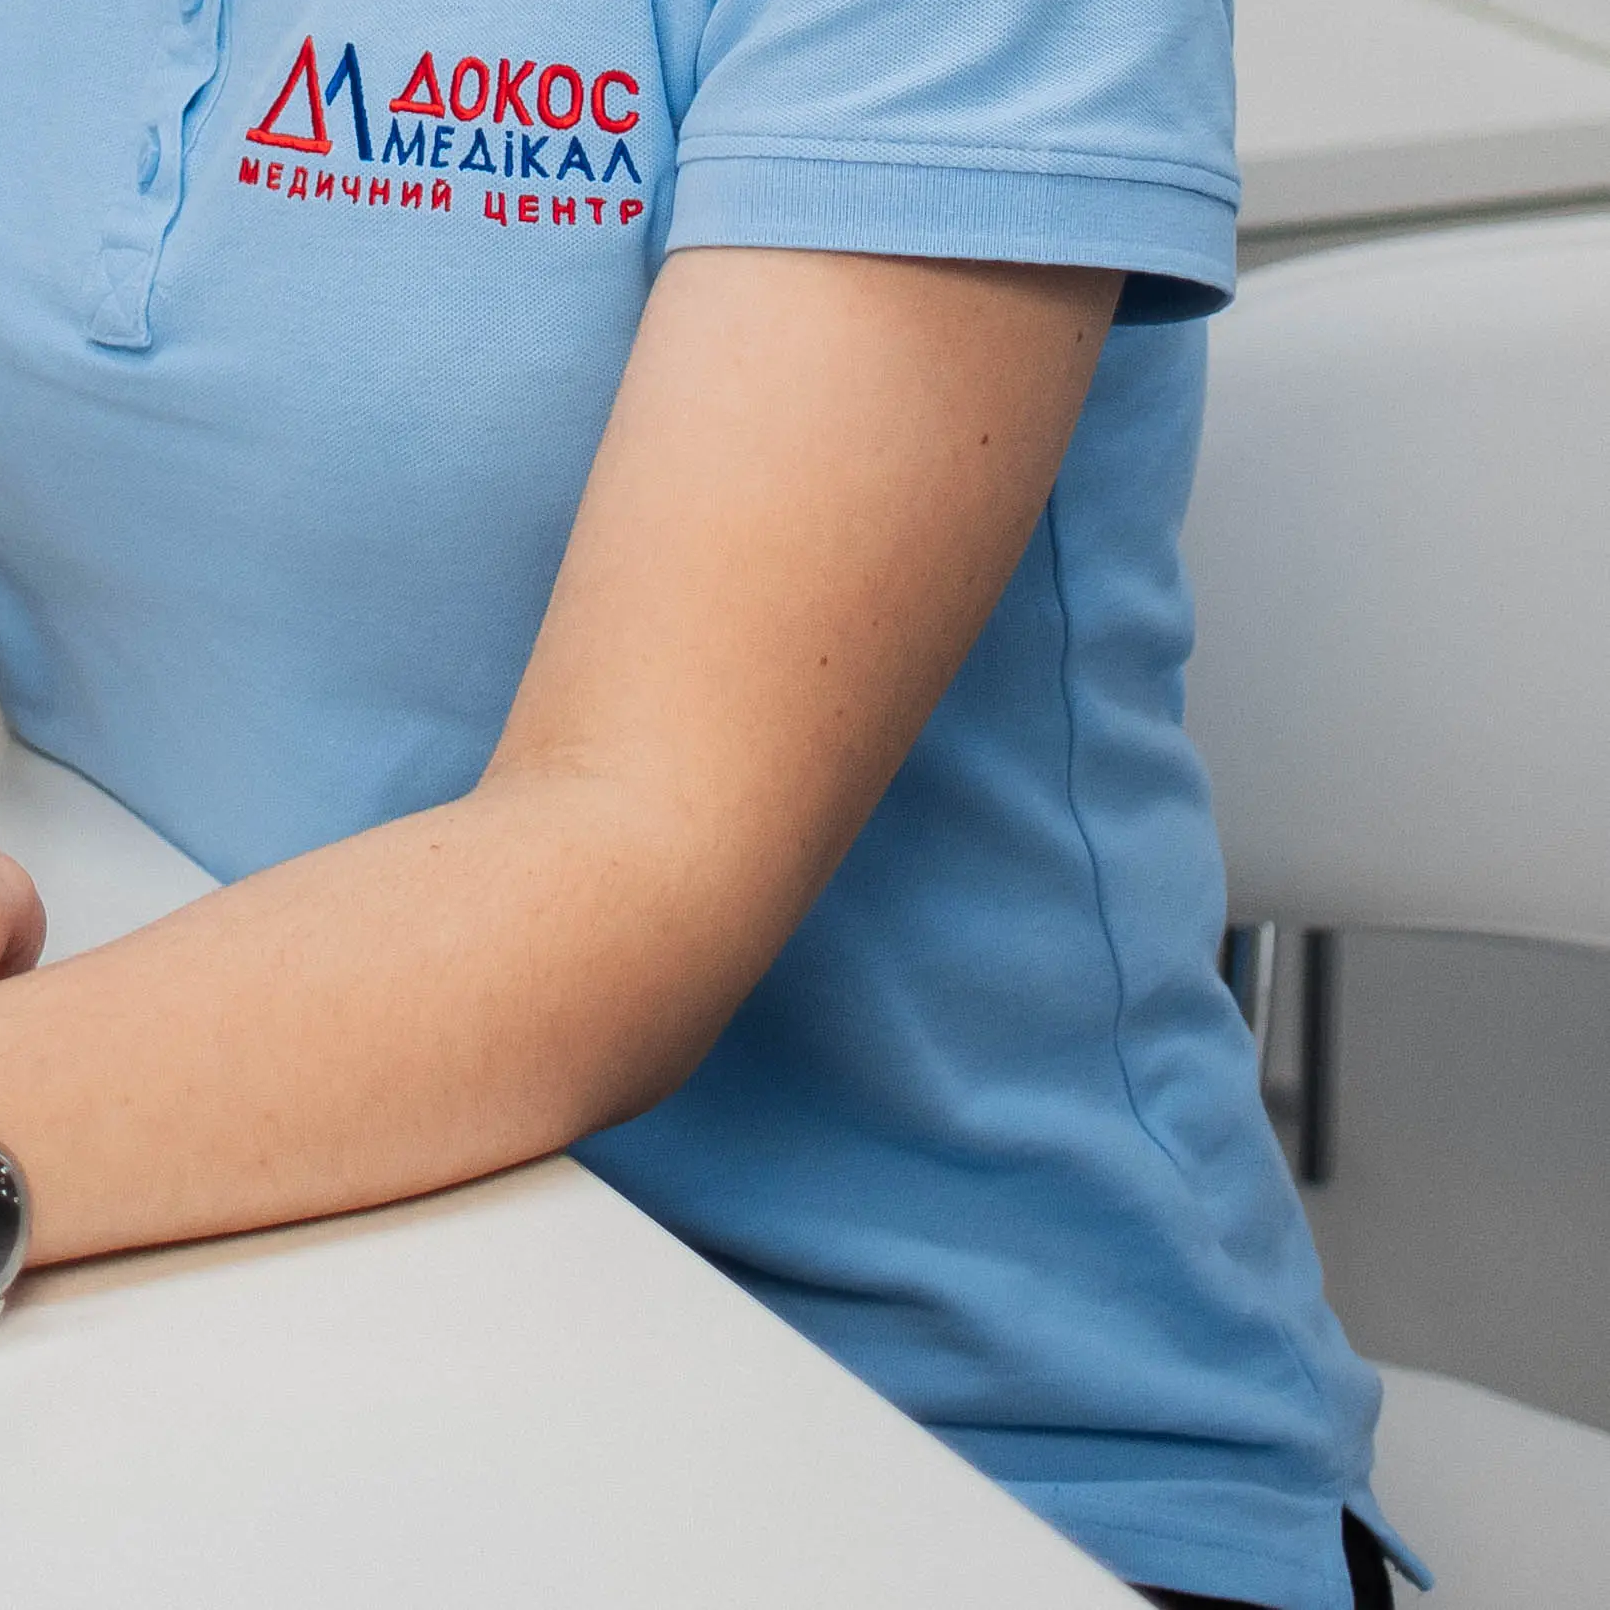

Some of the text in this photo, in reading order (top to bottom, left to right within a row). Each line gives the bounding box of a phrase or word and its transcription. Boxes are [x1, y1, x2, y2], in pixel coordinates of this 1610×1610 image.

[388, 50, 641, 135] ДОКОС
[238, 156, 645, 226] МЕДИЧНИЙ ЦЕНТР
